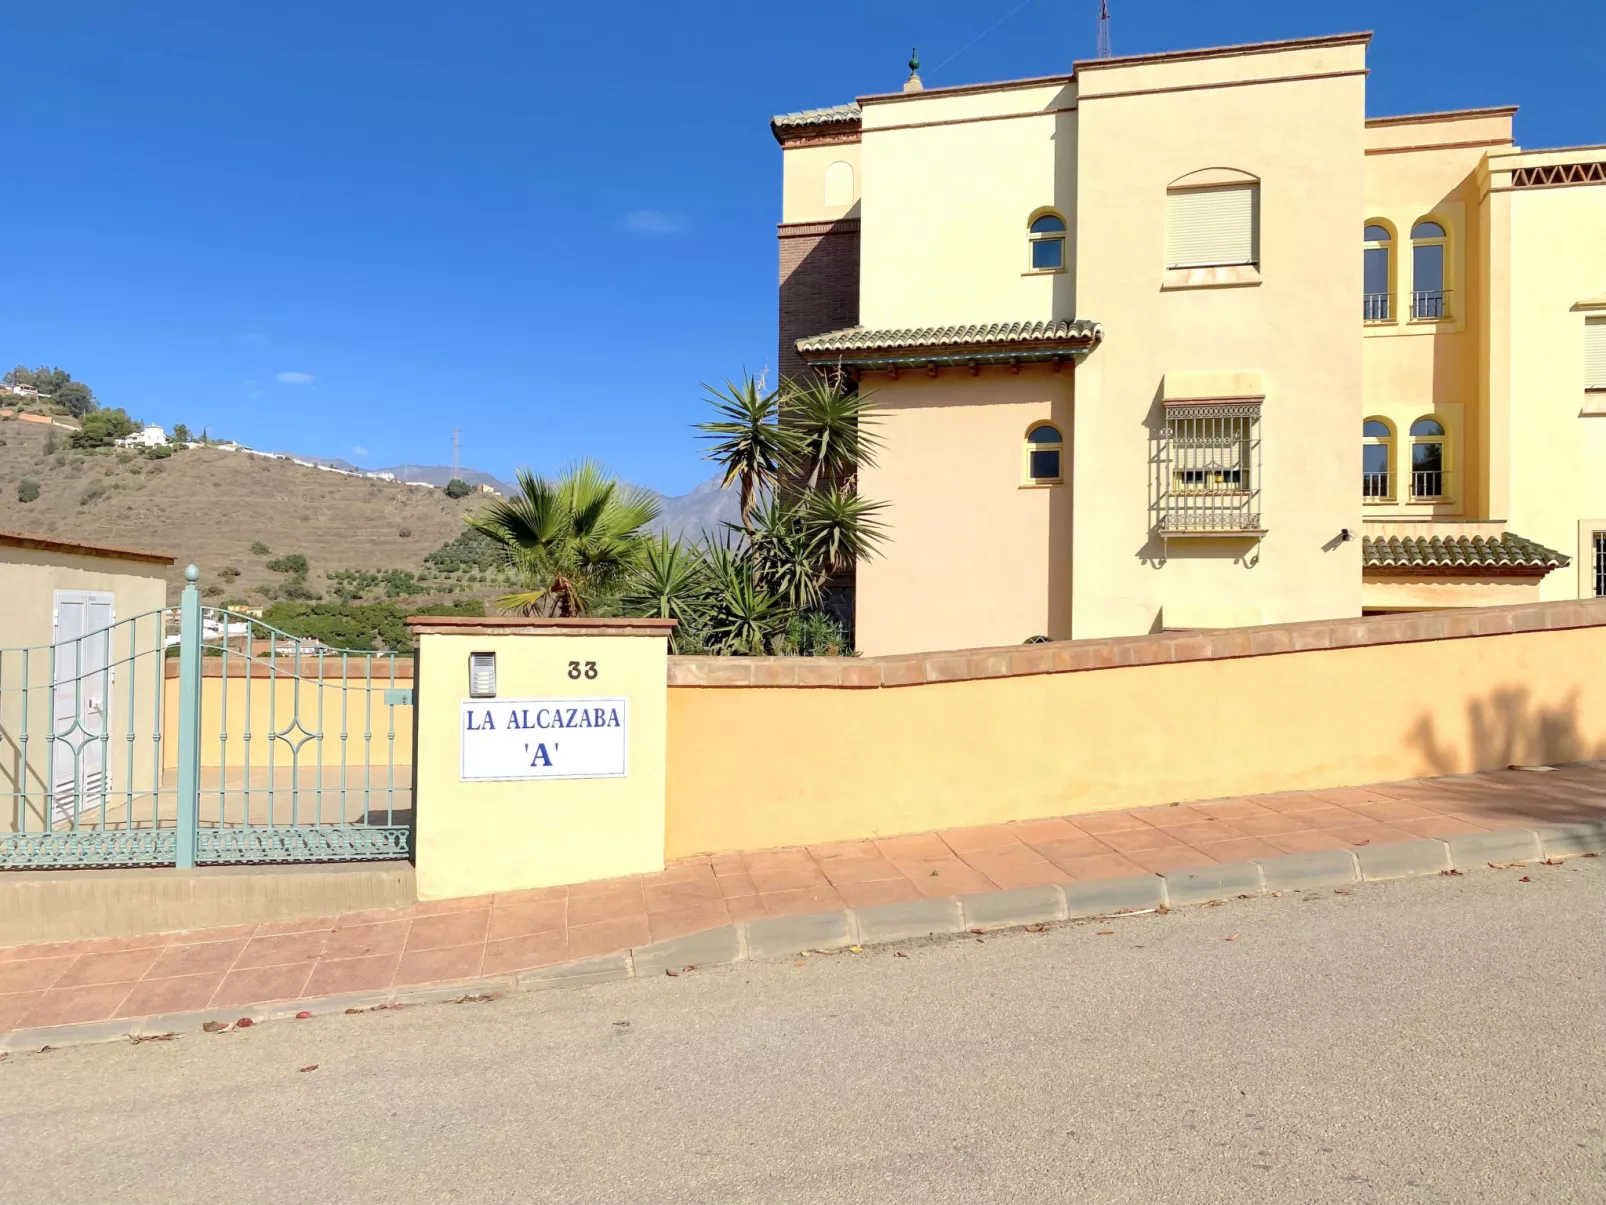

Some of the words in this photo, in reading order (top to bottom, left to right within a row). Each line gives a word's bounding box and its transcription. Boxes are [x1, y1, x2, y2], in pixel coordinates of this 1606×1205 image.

[568, 661, 598, 680] 33
[466, 710, 496, 730] LA
[506, 708, 621, 730] ALCAZABA
